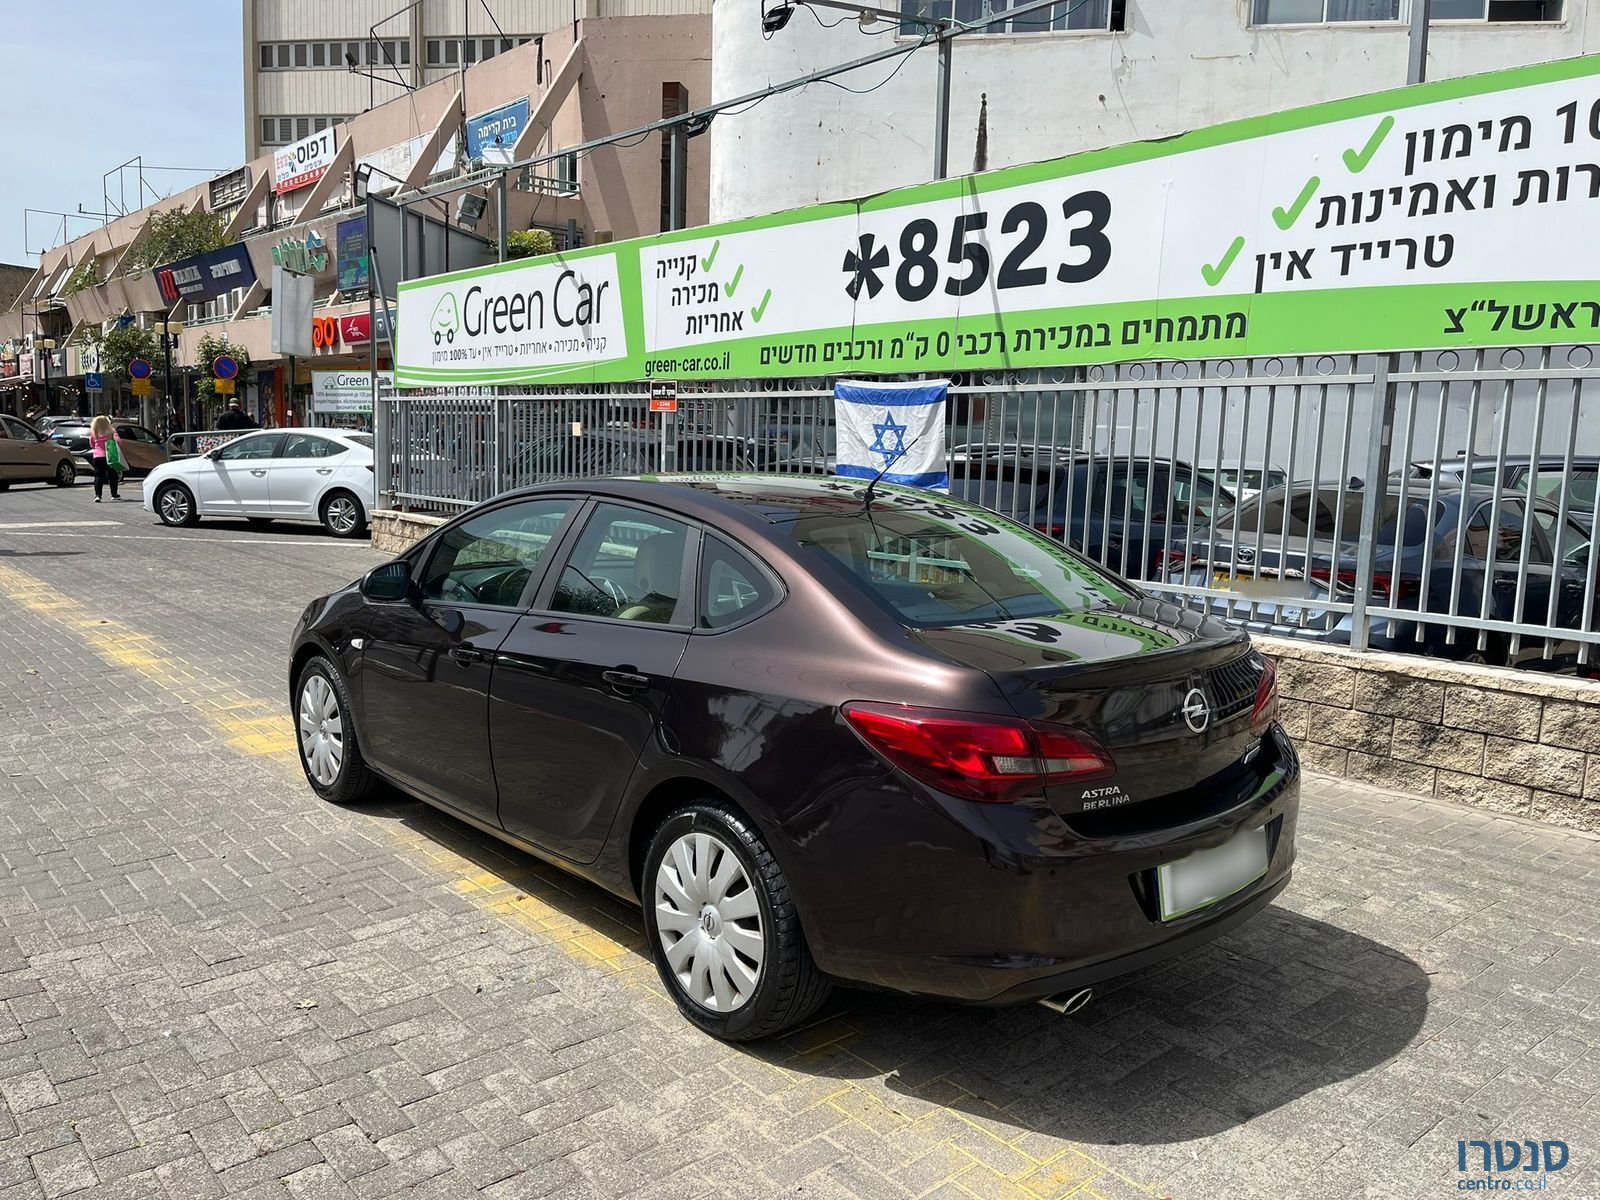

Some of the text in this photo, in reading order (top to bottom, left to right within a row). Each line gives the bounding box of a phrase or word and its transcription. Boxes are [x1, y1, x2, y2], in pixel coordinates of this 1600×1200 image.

[297, 136, 327, 164] דפוס
[1405, 115, 1533, 177] מימון
[1316, 173, 1497, 229] ואמינות
[656, 254, 697, 281] קנייה
[1254, 233, 1455, 294] טרייד אין
[463, 269, 609, 337] Green Car
[671, 282, 719, 308] מכירה
[686, 310, 744, 336] אחריות
[1121, 312, 1247, 346] מתמחים
[519, 340, 547, 356] אחריות
[554, 337, 579, 354] מכירה
[823, 335, 882, 362] ורכבים
[937, 331, 950, 357] 0
[956, 330, 1007, 356] רכבי
[1013, 322, 1112, 352] במכירת
[450, 348, 468, 361] 100%
[645, 351, 730, 377] green-car.co.il
[760, 345, 817, 365] חדשים
[337, 374, 369, 387] Green
[1081, 785, 1120, 799] ASTRA
[1082, 794, 1130, 811] BERLINA
